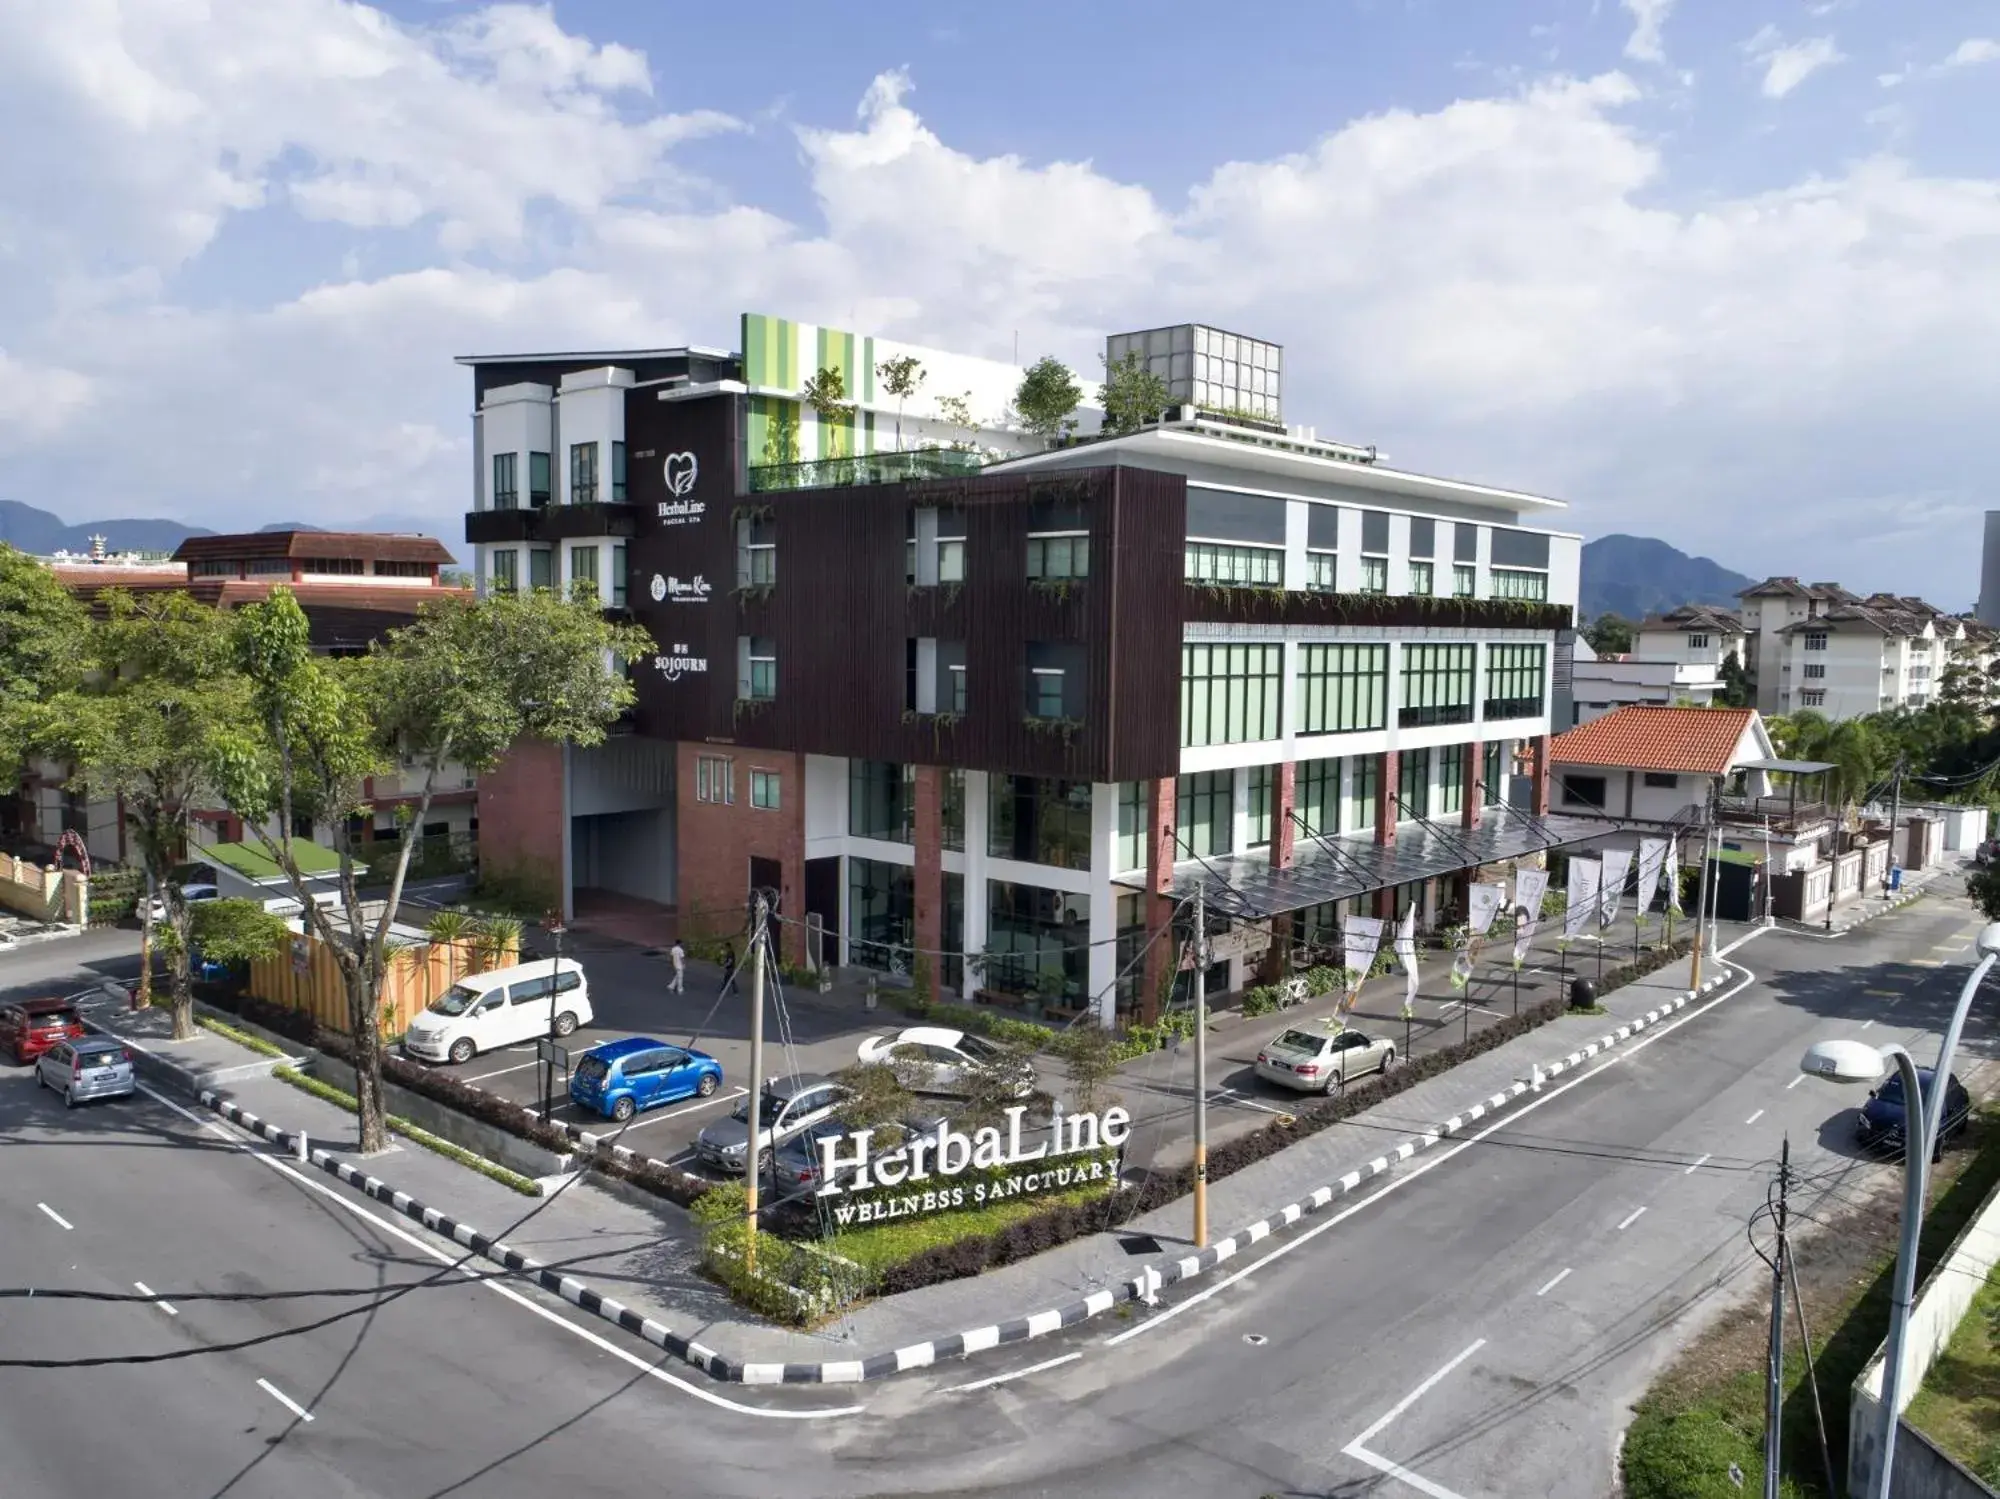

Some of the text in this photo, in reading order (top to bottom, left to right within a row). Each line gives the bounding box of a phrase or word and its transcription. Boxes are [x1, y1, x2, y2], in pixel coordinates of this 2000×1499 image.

[658, 499, 706, 516] HerbaLine
[655, 656, 707, 673] SOJOURN
[816, 1101, 1131, 1197] HerbaLine
[834, 1158, 1121, 1225] WELLNESS SANCTUARY
